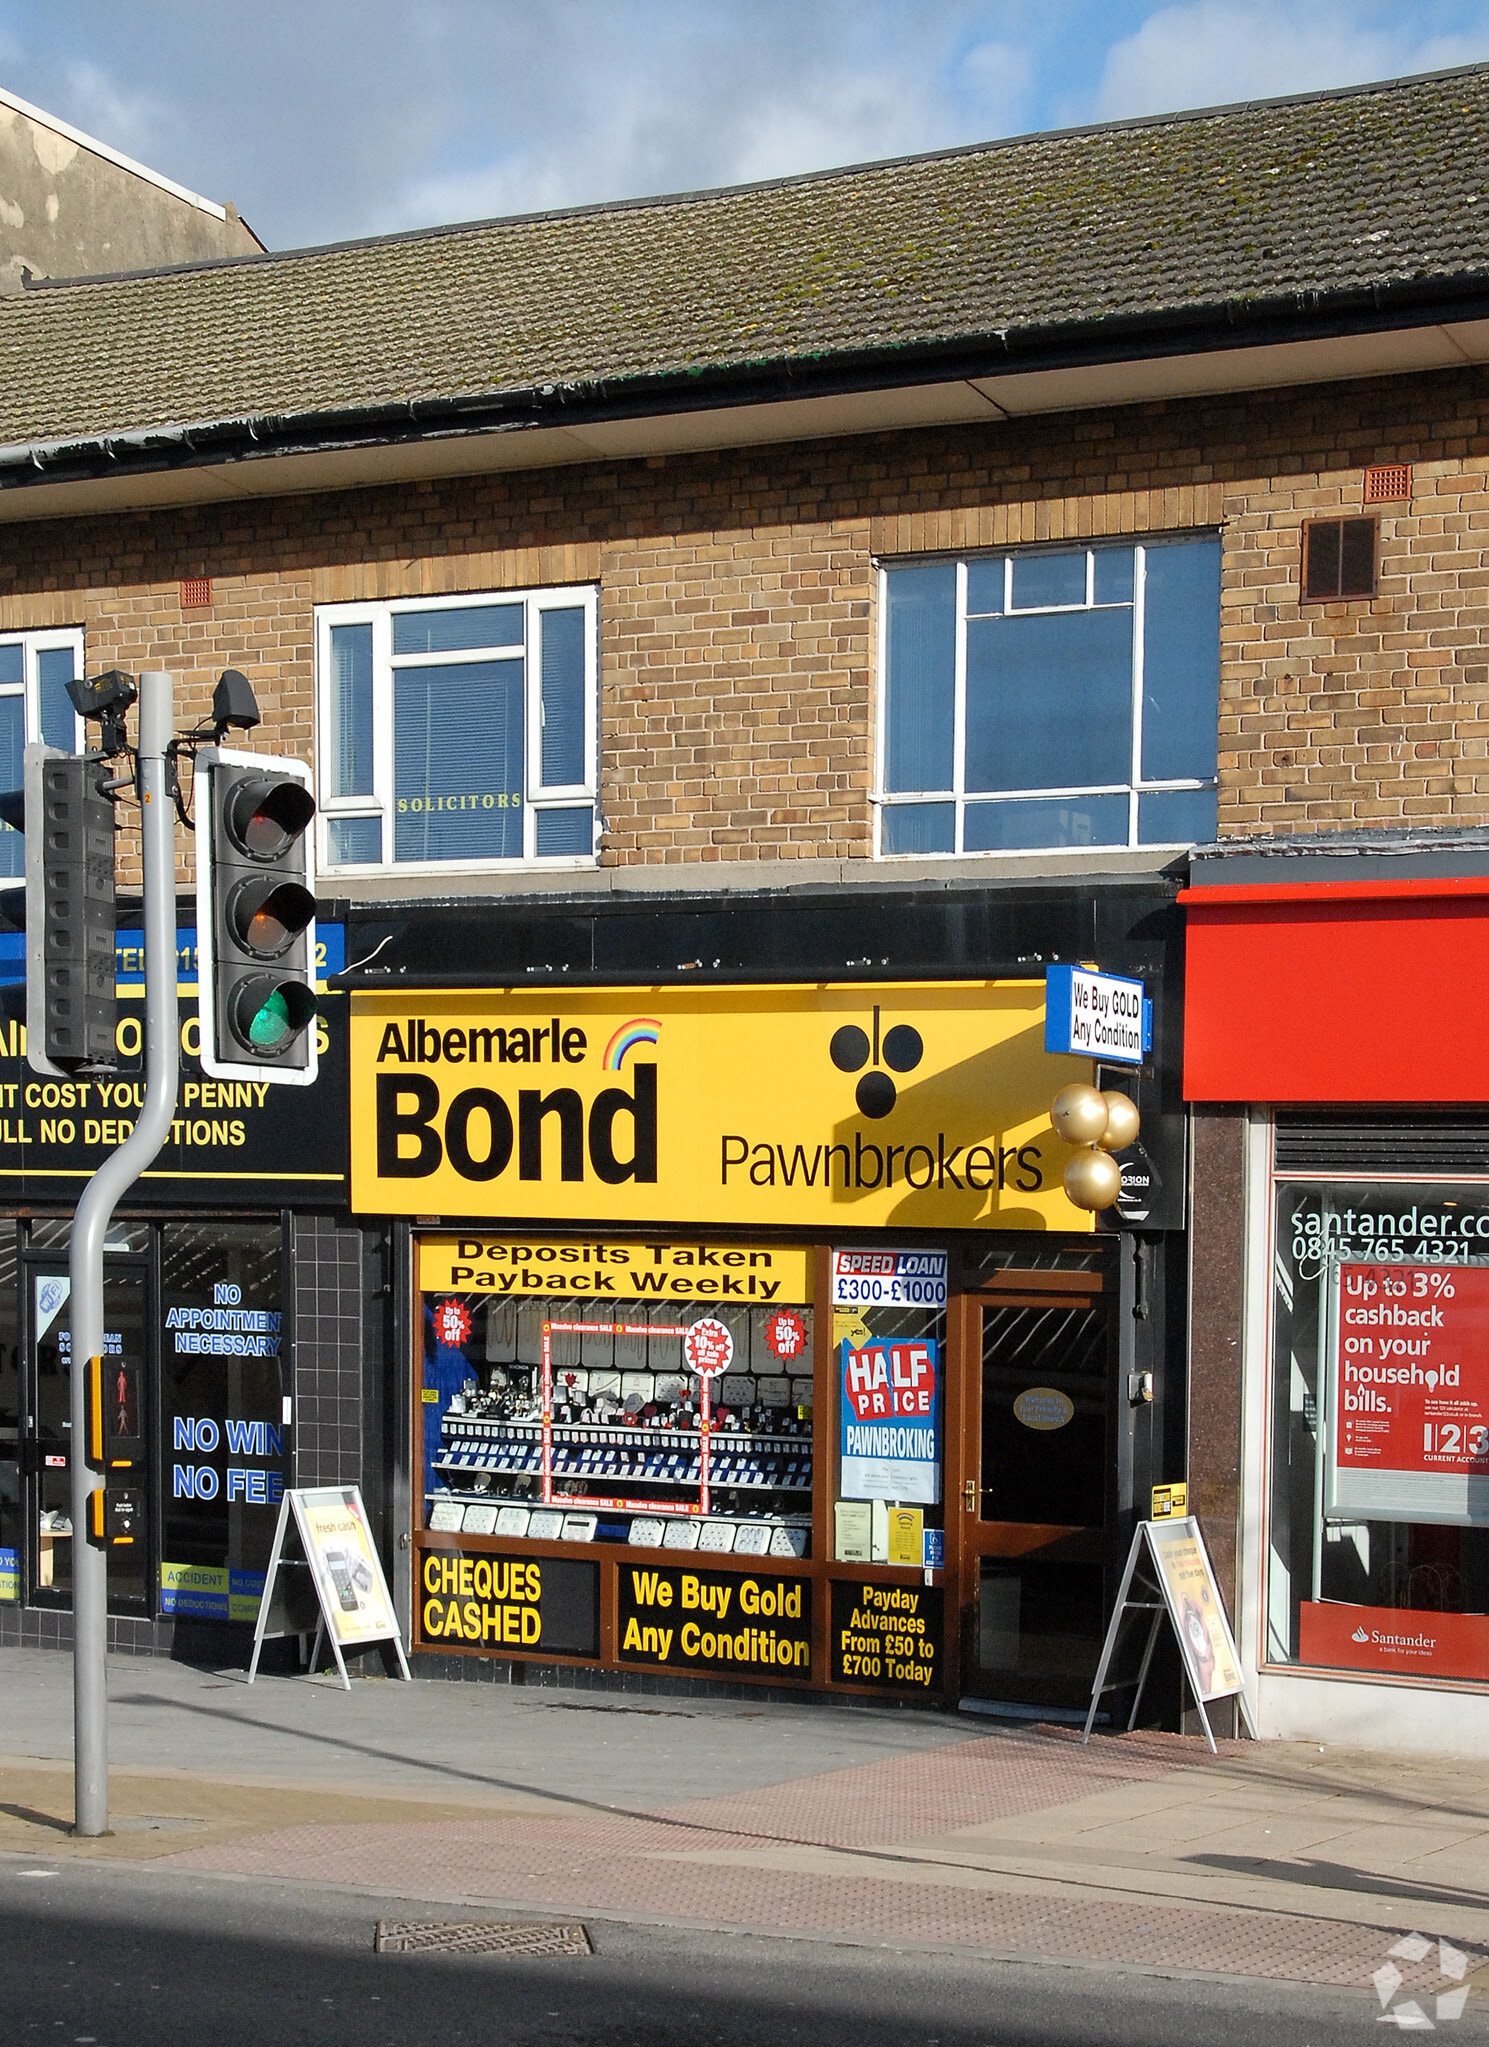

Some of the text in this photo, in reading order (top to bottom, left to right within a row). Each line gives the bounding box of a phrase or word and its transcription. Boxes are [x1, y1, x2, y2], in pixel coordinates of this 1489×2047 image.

[398, 793, 520, 813] SOLICITORS
[1074, 981, 1139, 1019] We Buy GOLD
[376, 1018, 587, 1063] Albemarle
[1073, 1014, 1140, 1050] Any Condition
[25, 1083, 91, 1108] COST
[184, 1083, 270, 1108] PENNY
[0, 1119, 246, 1146] LL NO DEDTIONS
[376, 1064, 658, 1185] Bond
[721, 1133, 1043, 1191] Pawnbrokers
[1121, 1175, 1149, 1184] ORION
[457, 1239, 773, 1268] Deposits Taken
[1292, 1236, 1469, 1264] 0845 765 4321
[839, 1254, 943, 1275] SPEED LOAN
[214, 1284, 241, 1305] NO
[451, 1266, 782, 1299] Payback Weekly
[838, 1278, 946, 1302] £300-£1000
[1346, 1273, 1455, 1300] Up to 3%
[443, 1315, 465, 1329] 50%
[599, 1324, 613, 1332] SALE
[778, 1317, 794, 1326] Up to
[1345, 1303, 1444, 1327] cashback
[175, 1332, 281, 1356] NECESSARY
[445, 1329, 460, 1341] off
[694, 1336, 714, 1349] 10%
[775, 1327, 799, 1342] 50%
[778, 1342, 795, 1354] off
[1344, 1336, 1431, 1360] on your
[849, 1350, 927, 1392] HALF
[1344, 1360, 1460, 1388] household
[858, 1391, 929, 1415] PRICE
[1344, 1386, 1392, 1413] bills.
[174, 1416, 283, 1456] NO WIN
[847, 1425, 935, 1460] PAWNBROKING
[1424, 1454, 1489, 1463] CURRENT ACCOUNT
[174, 1464, 283, 1505] NO FEE
[600, 1499, 613, 1507] SALE
[675, 1504, 689, 1512] SALE
[316, 1521, 356, 1533] fresh cash
[167, 1571, 223, 1587] ACCIDENT
[424, 1556, 541, 1602] CHEQUES
[165, 1598, 176, 1606] NO
[632, 1571, 801, 1619] We Buy Gold
[863, 1586, 919, 1614] Payday
[424, 1599, 541, 1644] CASHED
[850, 1607, 926, 1634] Advances
[623, 1617, 809, 1667] Any Condition
[841, 1630, 934, 1658] From £50 to
[1371, 1630, 1437, 1648] Santander
[843, 1654, 933, 1686] £700 Today
